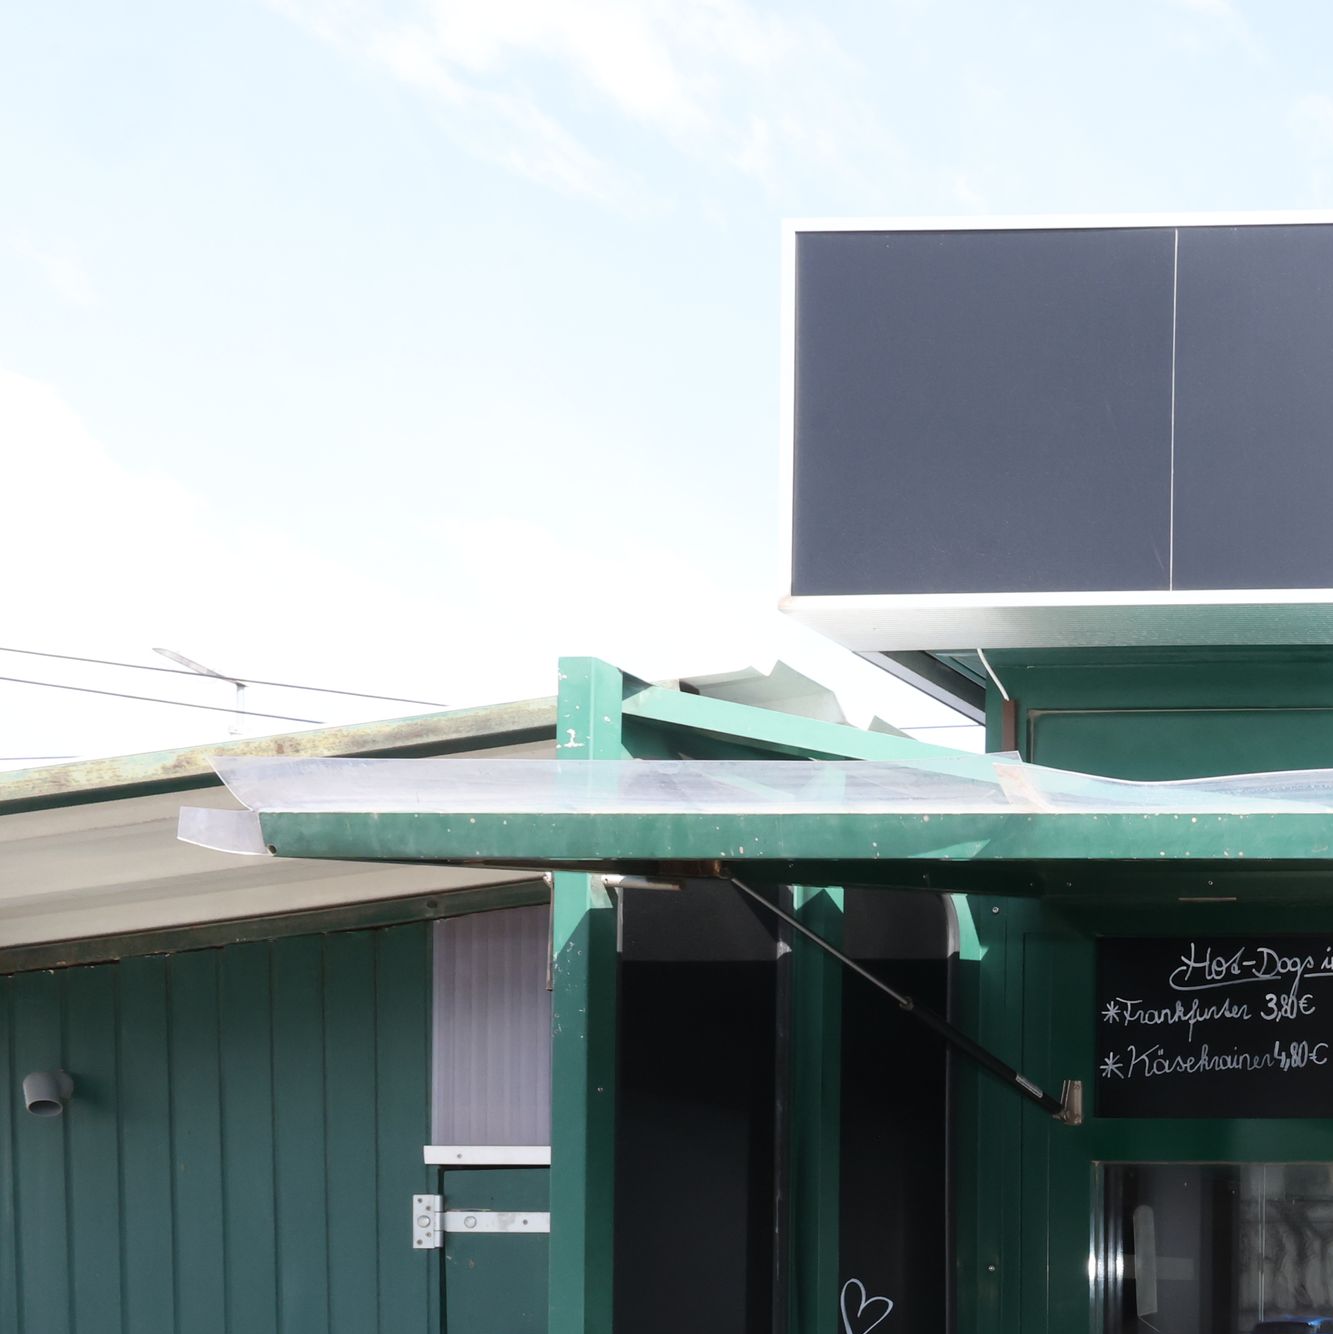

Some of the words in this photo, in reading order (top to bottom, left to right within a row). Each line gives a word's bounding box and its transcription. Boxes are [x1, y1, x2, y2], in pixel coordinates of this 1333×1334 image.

[1181, 943, 1313, 1003] Hot-Dogs
[1122, 998, 1252, 1041] Frankfurter
[1126, 1044, 1274, 1078] Käsekrainer
